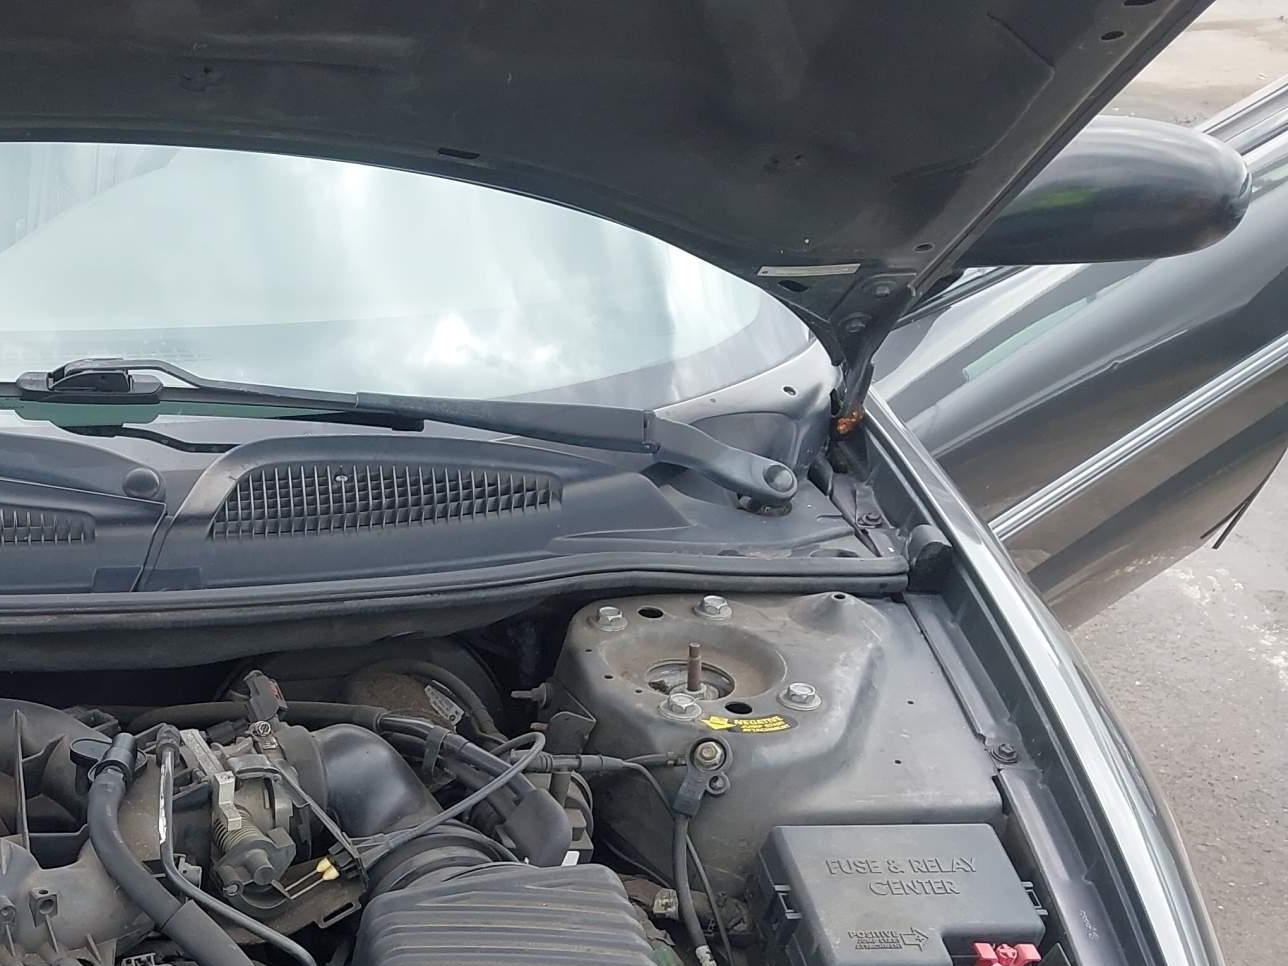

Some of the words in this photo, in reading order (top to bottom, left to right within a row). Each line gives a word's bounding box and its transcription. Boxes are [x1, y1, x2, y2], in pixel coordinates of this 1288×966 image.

[825, 858, 882, 874] FUSE
[887, 859, 904, 873] &
[908, 857, 976, 873] RELAY
[869, 880, 960, 895] CENTER
[848, 930, 899, 939] POSITIVE
